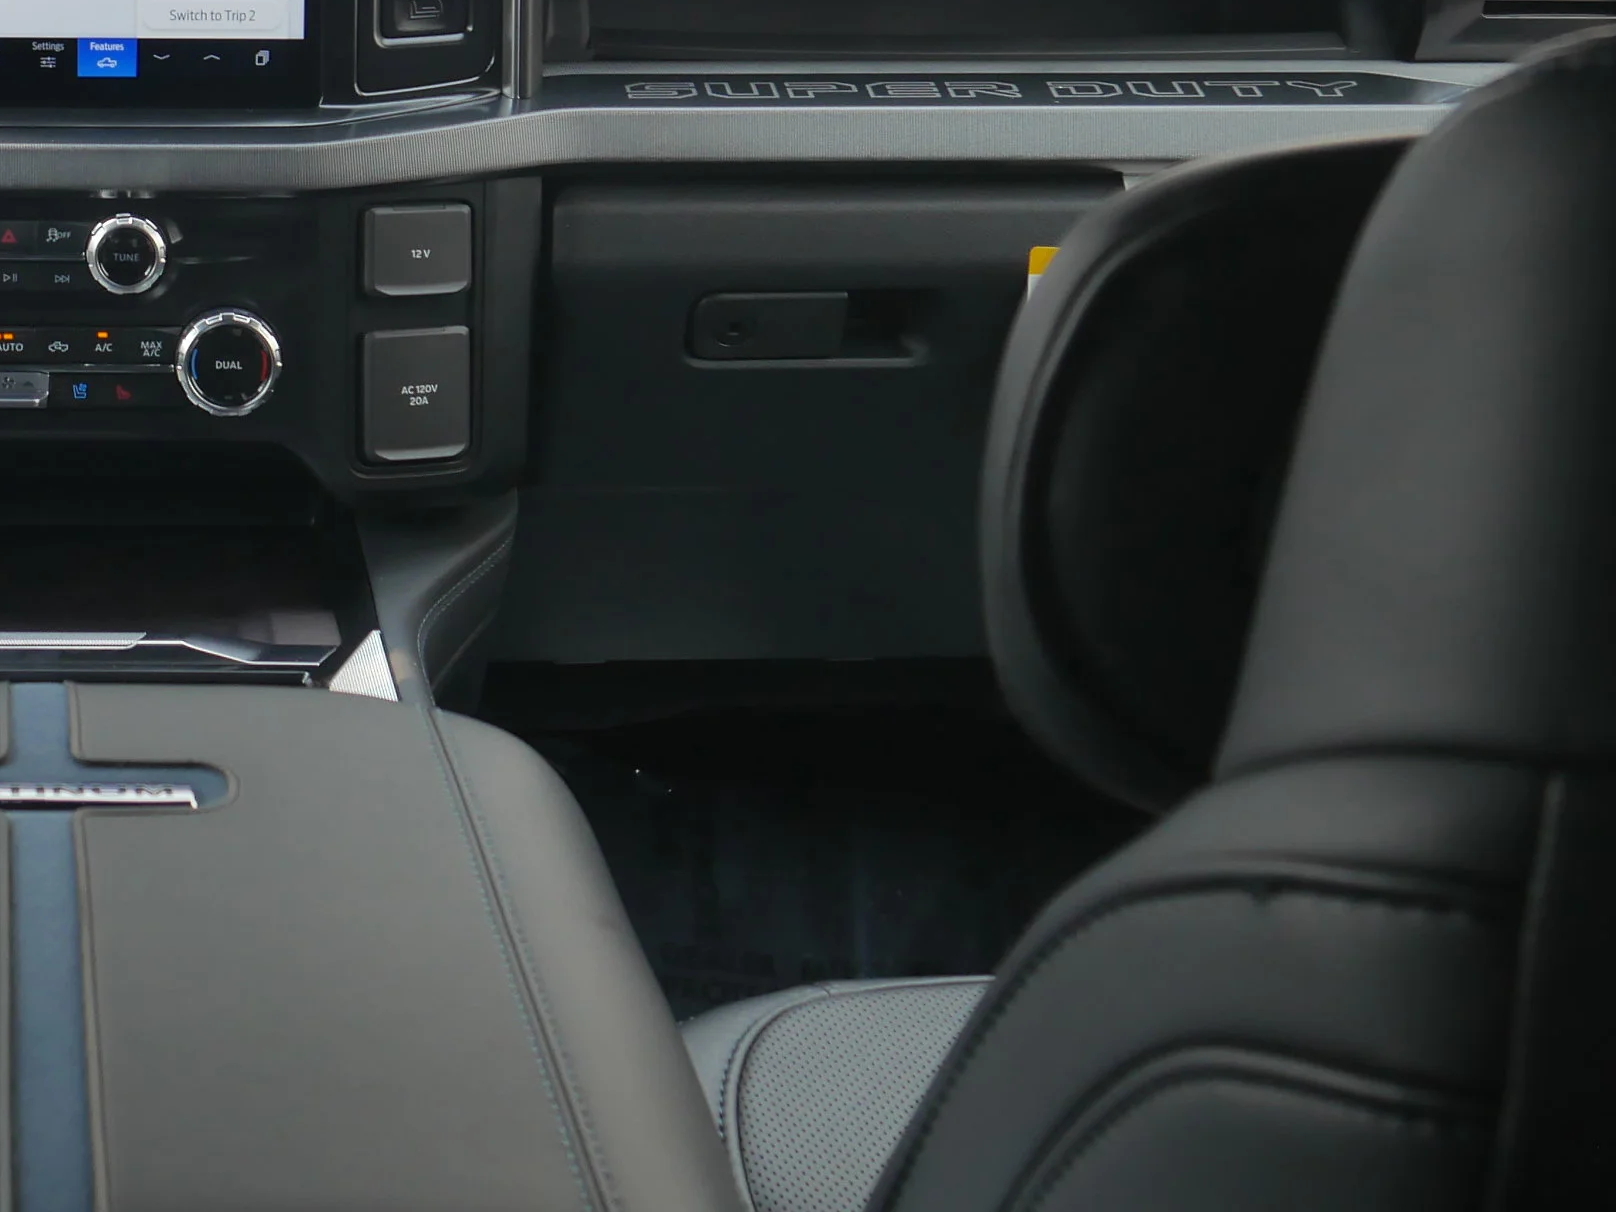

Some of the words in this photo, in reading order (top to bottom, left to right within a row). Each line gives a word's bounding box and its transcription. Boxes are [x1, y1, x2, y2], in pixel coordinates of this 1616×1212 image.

[170, 8, 208, 22] Switch
[211, 9, 223, 21] to
[225, 9, 247, 24] Trip
[249, 9, 256, 21] 2
[32, 41, 65, 53] Settings
[90, 42, 125, 52] Features
[624, 81, 1022, 100] SUPER
[1048, 80, 1359, 99] DUTY
[113, 252, 140, 262] TUNE
[95, 343, 112, 352] A/C
[140, 341, 163, 351] MAX
[143, 349, 161, 358] A/C
[215, 360, 243, 370] DUAL
[401, 387, 415, 396] AC
[415, 384, 438, 394] 120V
[409, 396, 429, 406] 20A
